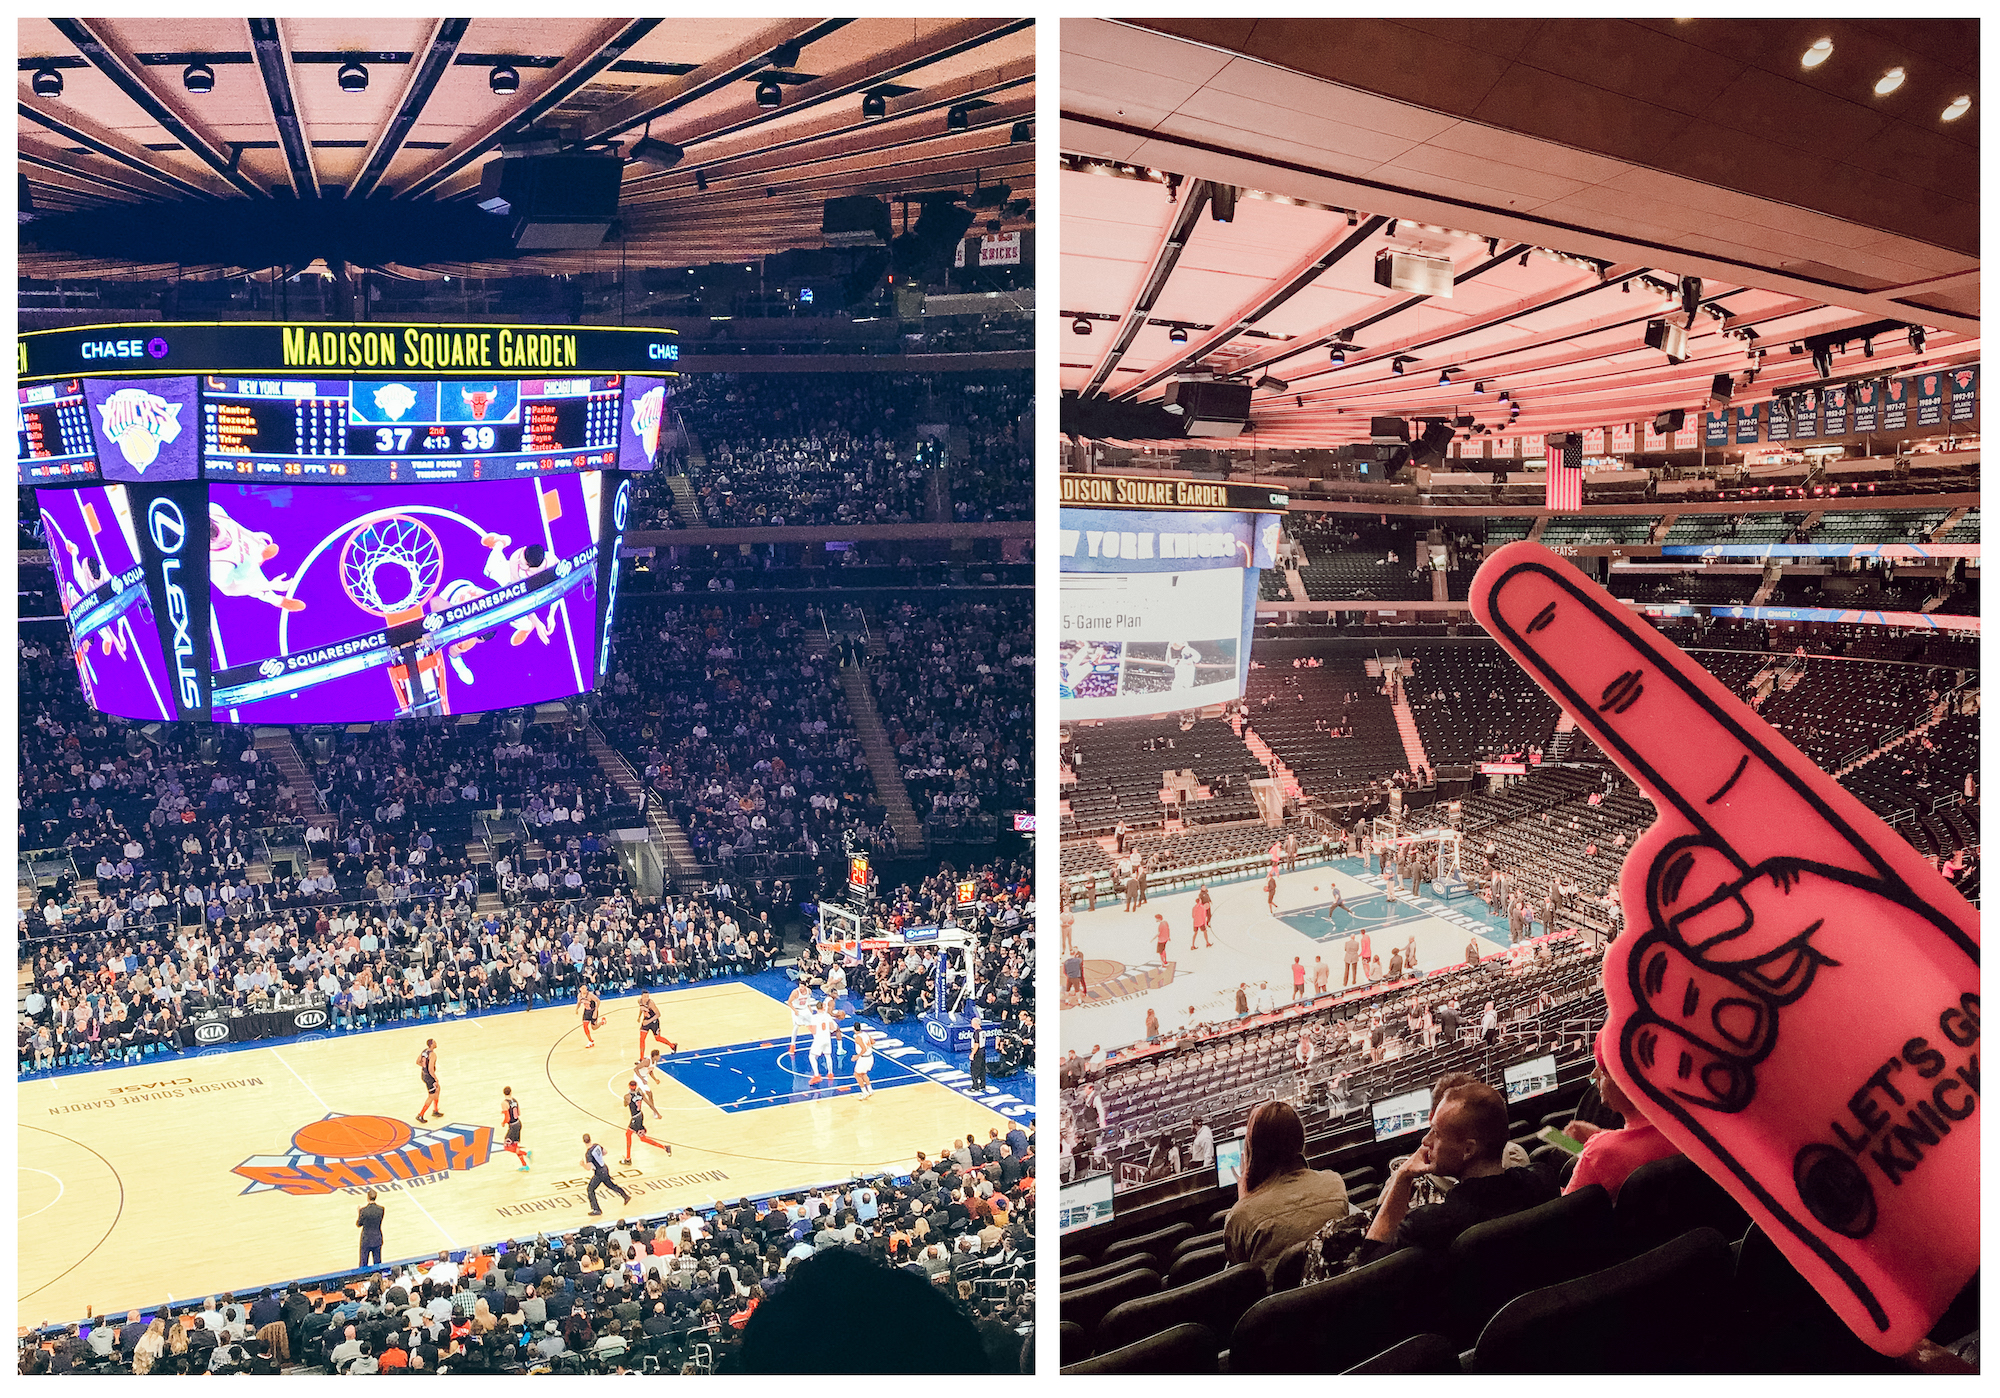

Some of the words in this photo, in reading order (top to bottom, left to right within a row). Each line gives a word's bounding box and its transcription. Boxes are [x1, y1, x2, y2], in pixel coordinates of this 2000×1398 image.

[982, 247, 1018, 260] KNICKS
[81, 340, 144, 360] CHASE
[282, 327, 396, 366] MADISON
[404, 328, 492, 369] SQUARE
[498, 329, 577, 367] GARDEN
[649, 343, 679, 360] CHASE
[238, 380, 258, 394] NEW
[259, 380, 281, 395] YORK
[1952, 392, 1974, 401] 1992-93
[532, 405, 556, 414] Parker
[1856, 406, 1876, 414] 1970-71
[376, 428, 412, 452] 37
[429, 427, 446, 436] 2nd
[461, 426, 496, 450] 39
[422, 436, 450, 450] 4:13
[1614, 442, 1634, 450] KNICKS
[1646, 440, 1664, 448] KNICKS
[1676, 437, 1696, 446] KNICKS
[1584, 444, 1602, 452] KNICKS
[236, 462, 254, 474] 31
[284, 463, 302, 475] 35
[329, 464, 347, 476] 78
[390, 461, 398, 470] 3
[474, 460, 481, 468] 2
[540, 458, 554, 470] 30
[574, 456, 587, 466] 45
[390, 471, 398, 480] 5
[474, 470, 481, 479] 5
[1116, 478, 1174, 504] SQUARE
[1176, 482, 1227, 506] GARDEN
[1086, 530, 1155, 560] YORK
[1159, 532, 1236, 559] KNICKS
[1550, 546, 1573, 556] SEATS
[573, 546, 599, 568] SQUA
[446, 582, 528, 622] SQUARESPACE
[1063, 614, 1112, 630] 5-Game
[1116, 614, 1142, 628] Plan
[162, 558, 201, 709] LEXUS
[287, 633, 387, 670] SQUARESPACE
[1484, 764, 1524, 773] Budweiser
[852, 867, 865, 884] 24
[1426, 903, 1494, 934] KNICKS
[300, 1013, 321, 1025] KIA
[200, 1026, 223, 1038] KIA
[930, 1026, 944, 1039] KIA
[107, 1077, 193, 1095] CHASE
[190, 1076, 264, 1096] MADISON
[122, 1088, 185, 1106] SQUARE
[1830, 1036, 1946, 1157] LET'S
[48, 1100, 116, 1116] GARDEN
[230, 1126, 494, 1196] KNICKS
[406, 1170, 450, 1188] NEW
[644, 1169, 730, 1191] MADISON
[496, 1196, 572, 1218] GARDEN
